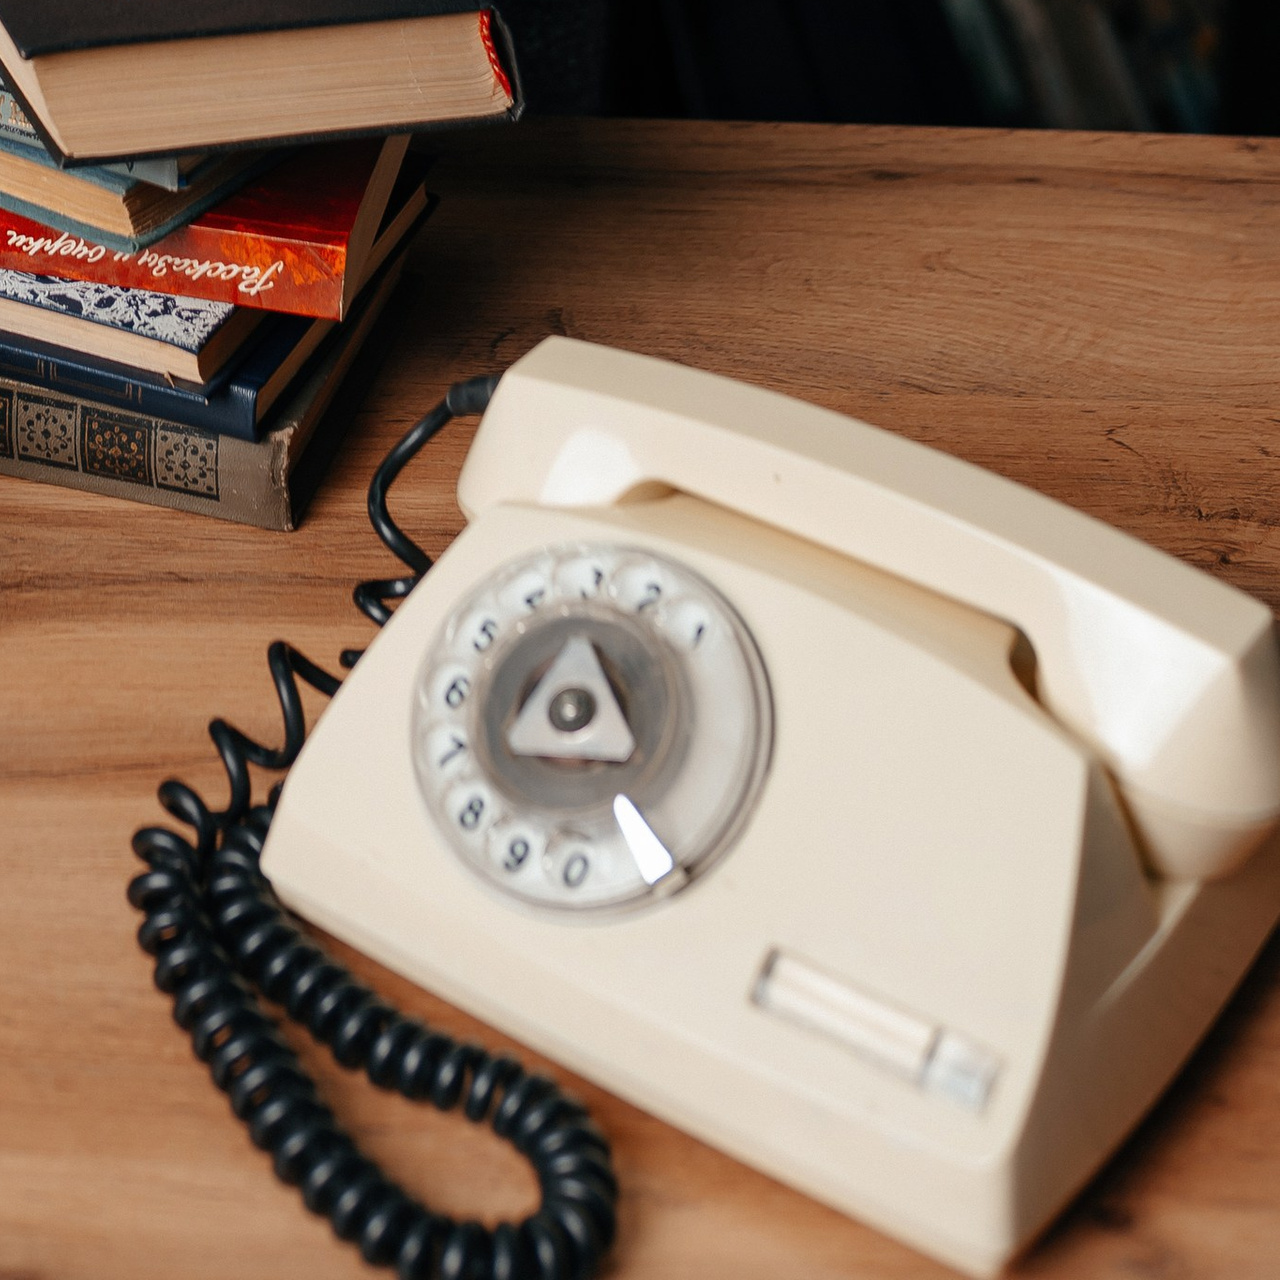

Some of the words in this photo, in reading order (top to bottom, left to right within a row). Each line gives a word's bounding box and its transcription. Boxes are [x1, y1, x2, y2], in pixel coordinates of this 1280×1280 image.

[4, 228, 105, 263] очерки
[136, 247, 283, 296] Рассказы
[444, 676, 470, 710] 6
[438, 735, 467, 768] 7
[459, 797, 485, 831] 8
[503, 838, 531, 873] 9
[562, 852, 591, 889] 0
